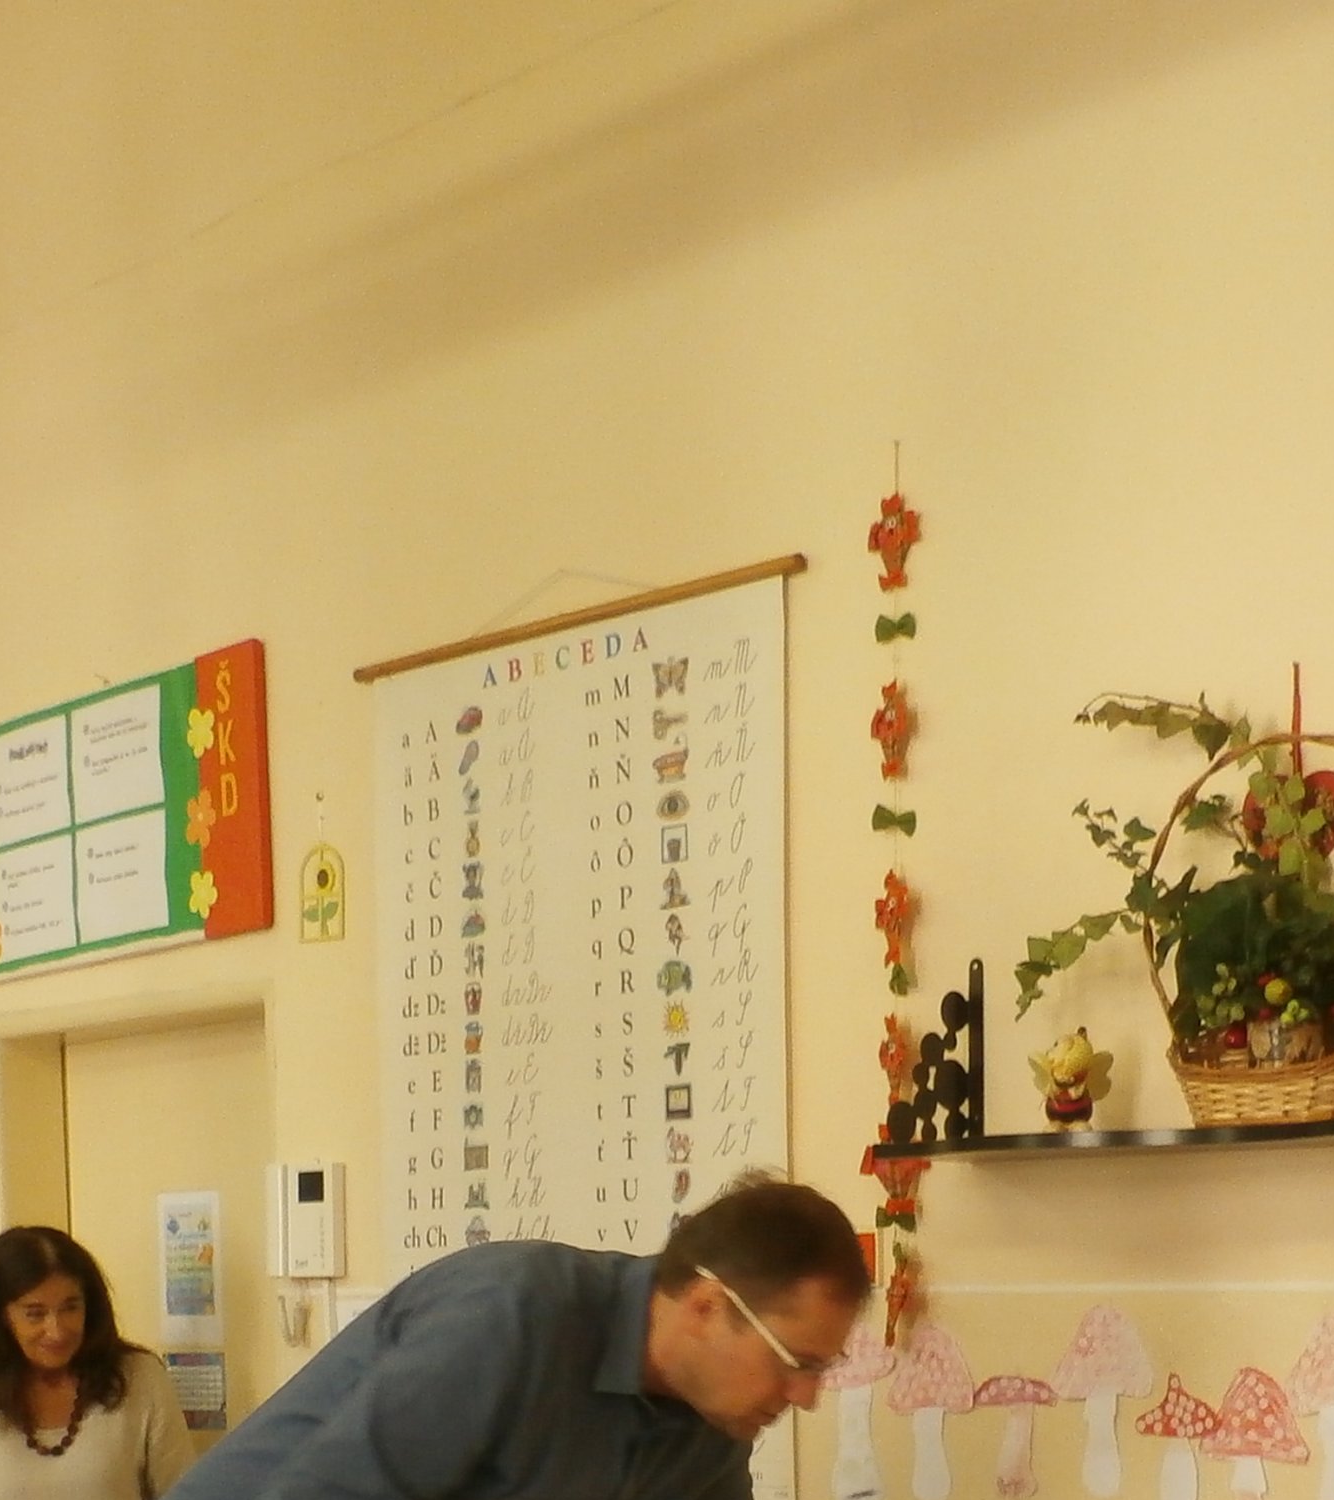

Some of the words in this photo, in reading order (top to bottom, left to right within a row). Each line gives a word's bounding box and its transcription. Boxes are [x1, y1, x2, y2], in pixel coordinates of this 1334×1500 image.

[613, 674, 631, 701] M
[615, 716, 630, 743] N
[428, 798, 439, 821] B
[430, 915, 442, 938] D
[620, 969, 635, 994] R
[431, 1187, 444, 1210] H
